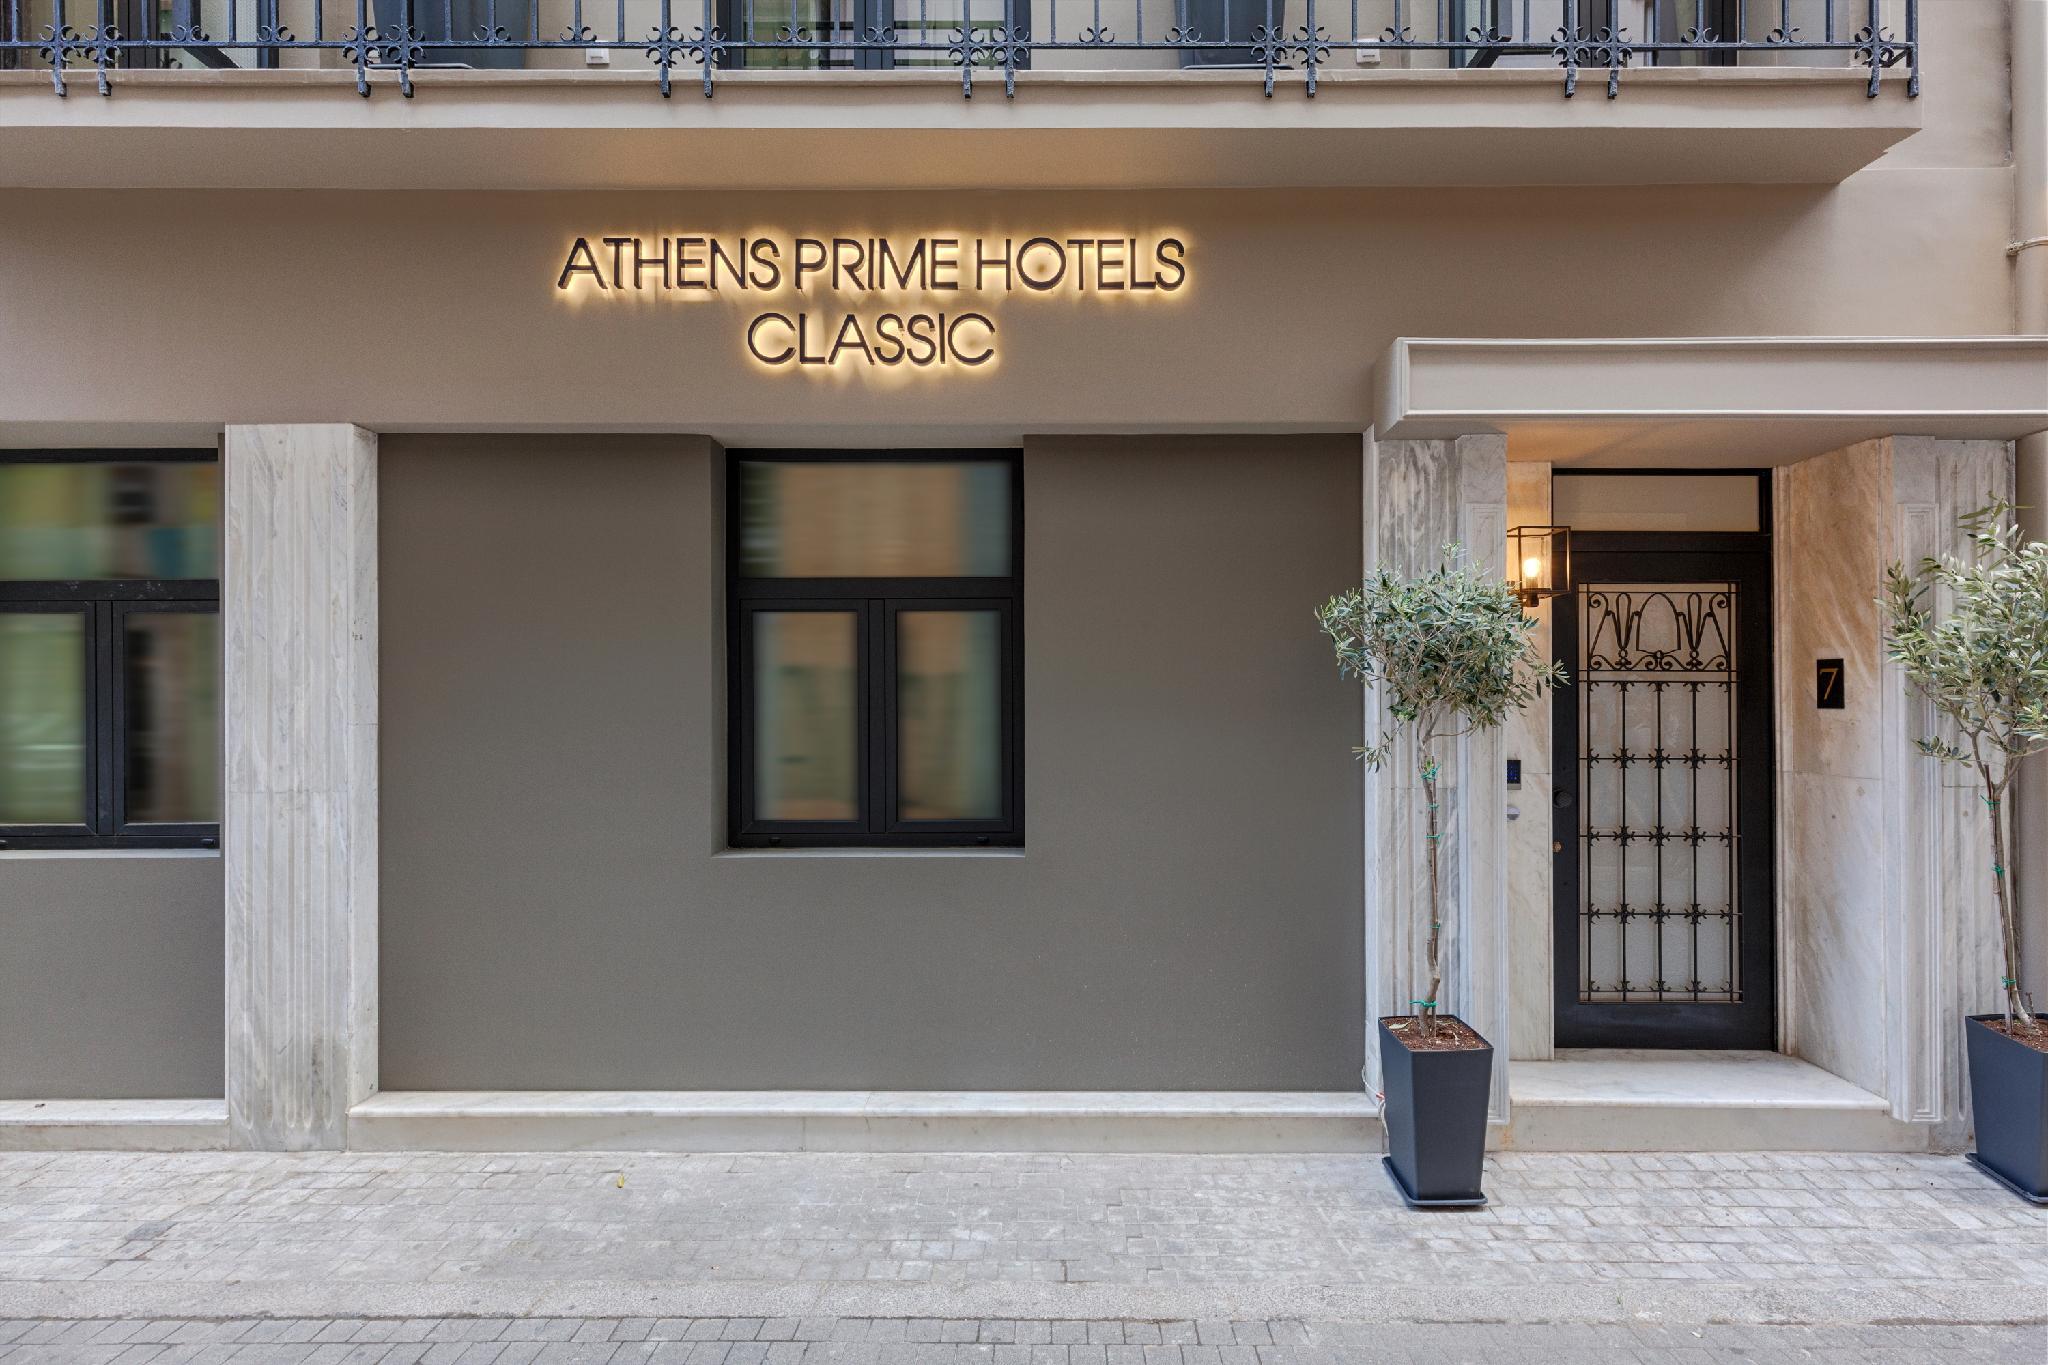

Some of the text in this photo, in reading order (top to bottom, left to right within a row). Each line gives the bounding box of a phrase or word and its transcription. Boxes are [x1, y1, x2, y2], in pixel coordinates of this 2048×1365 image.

[558, 237, 1185, 291] ATHENS PRIME HOTELS
[748, 312, 995, 365] CLASSIC
[1820, 668, 1839, 700] 7
